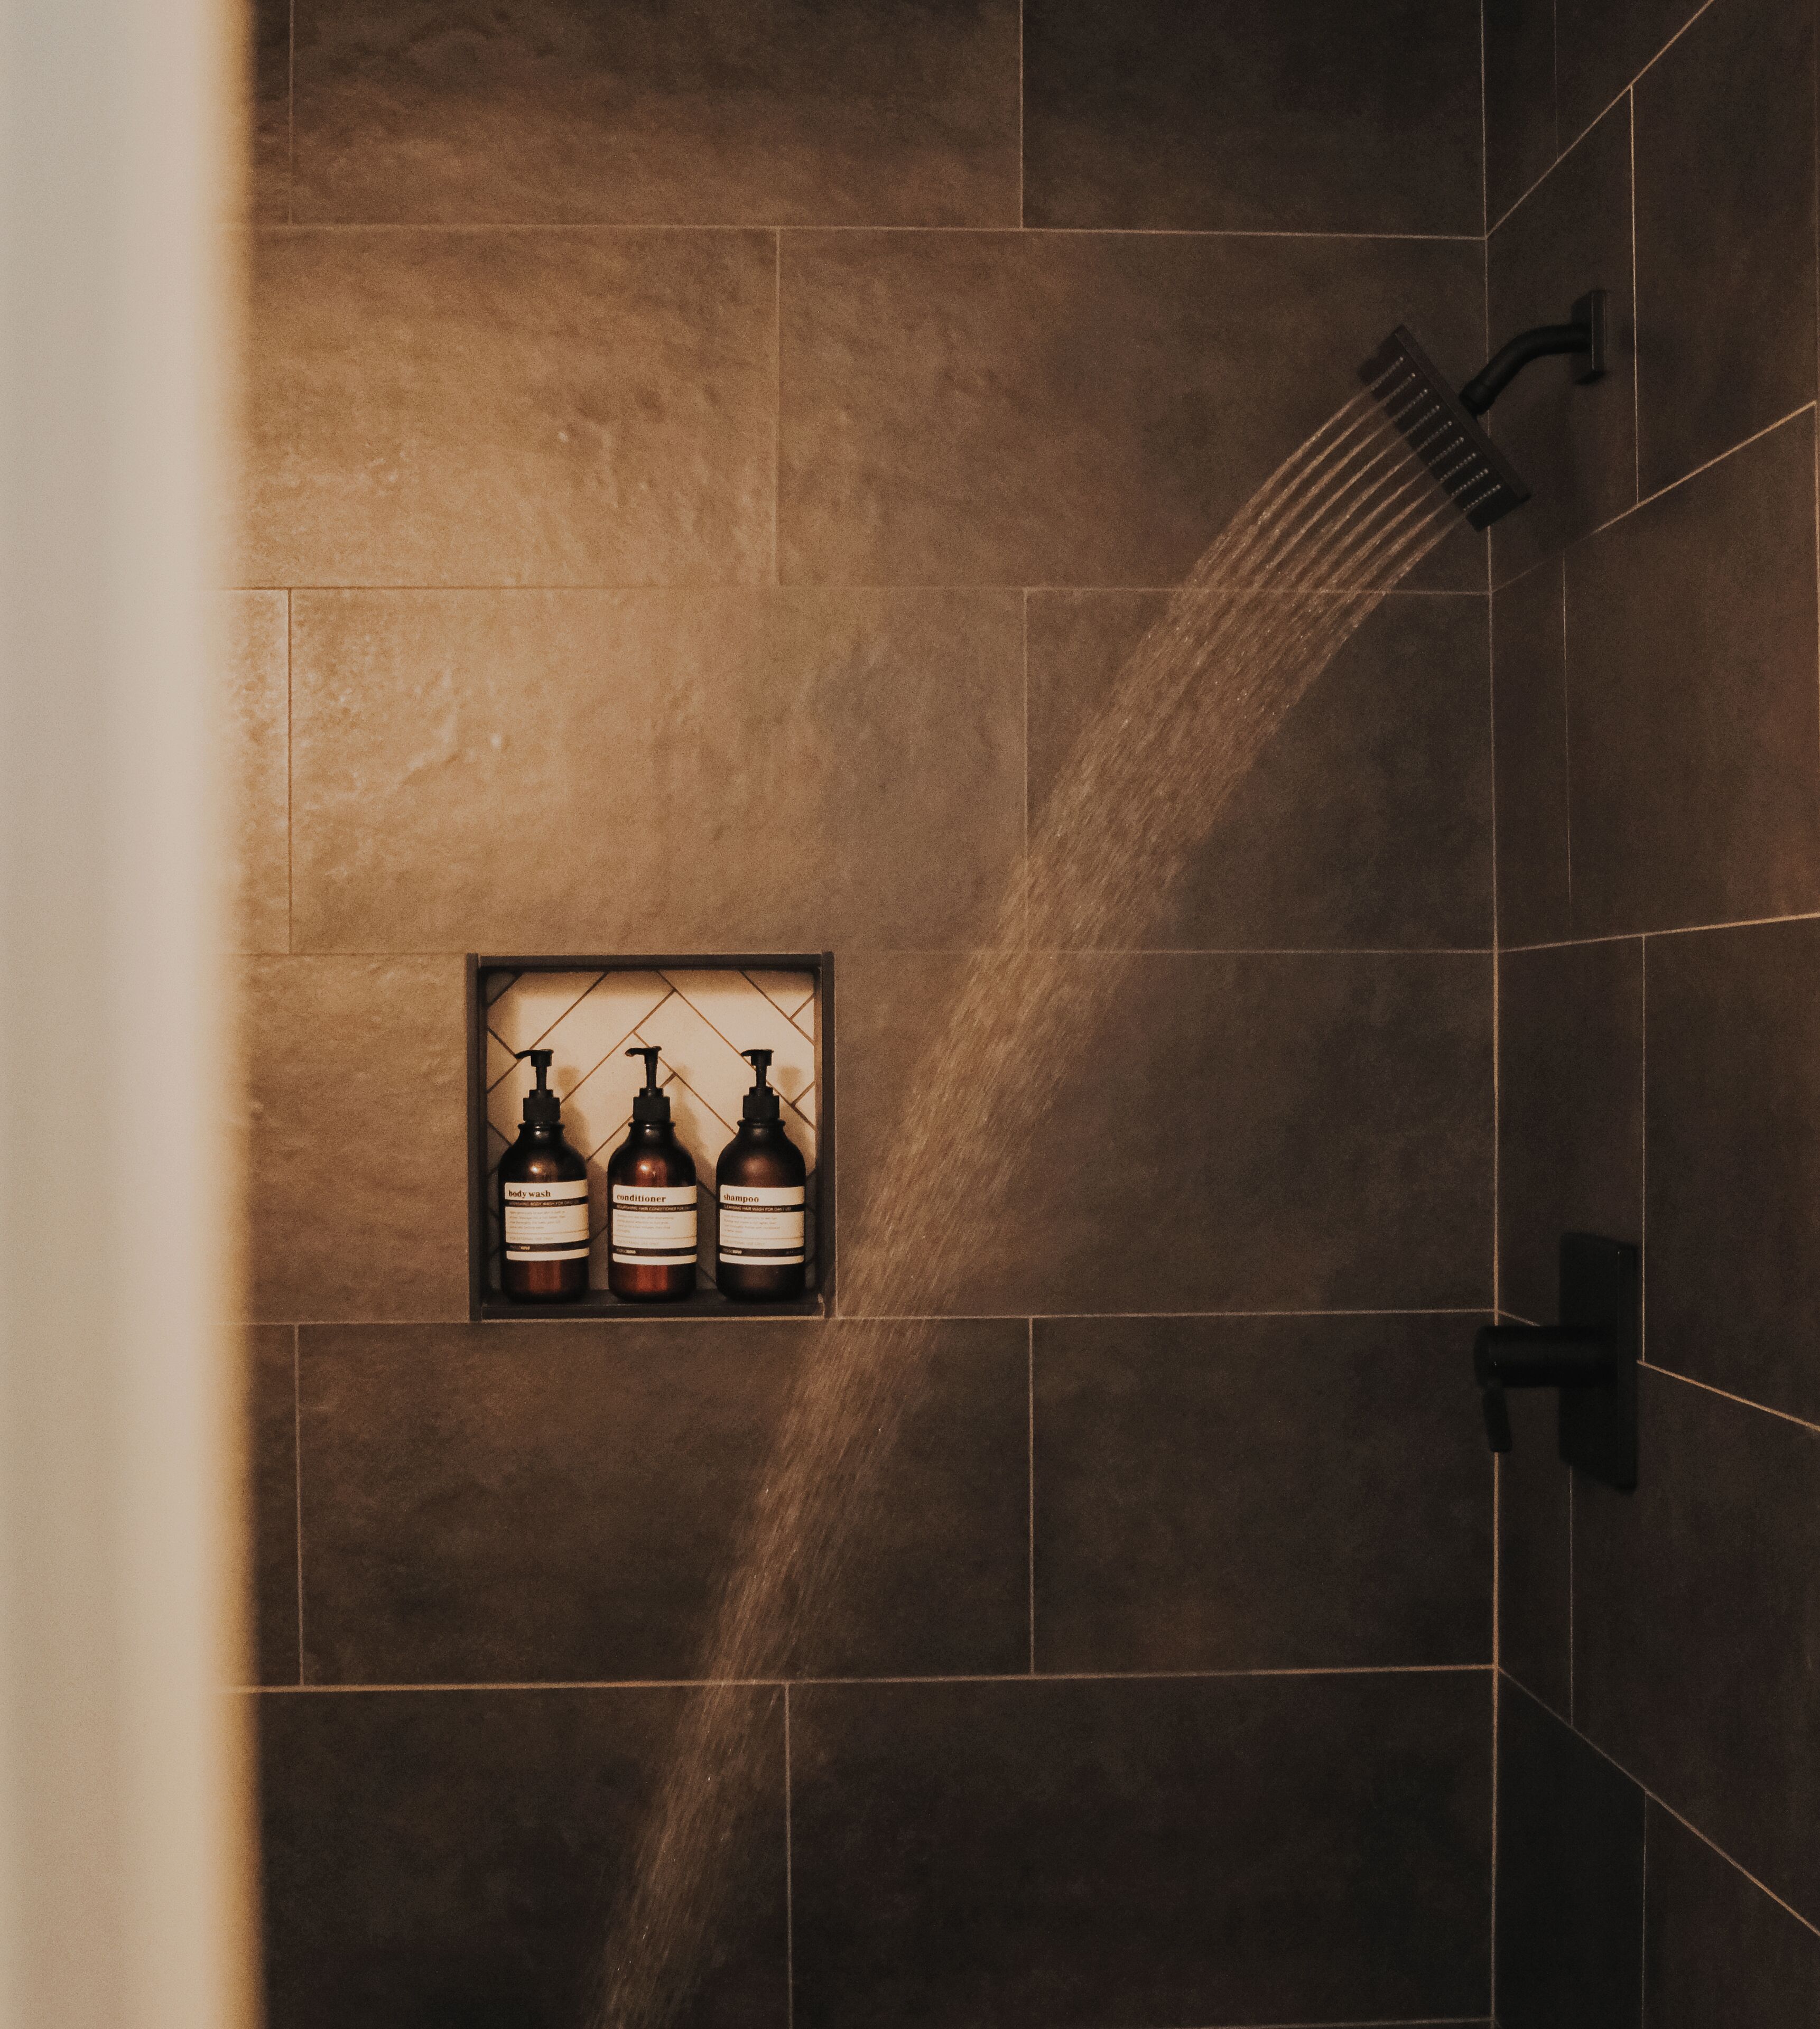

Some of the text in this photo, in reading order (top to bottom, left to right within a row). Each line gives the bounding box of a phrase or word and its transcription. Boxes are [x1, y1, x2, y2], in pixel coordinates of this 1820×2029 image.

[509, 1190, 526, 1198] body
[617, 1194, 666, 1203] conditioner
[723, 1193, 759, 1203] shampoo
